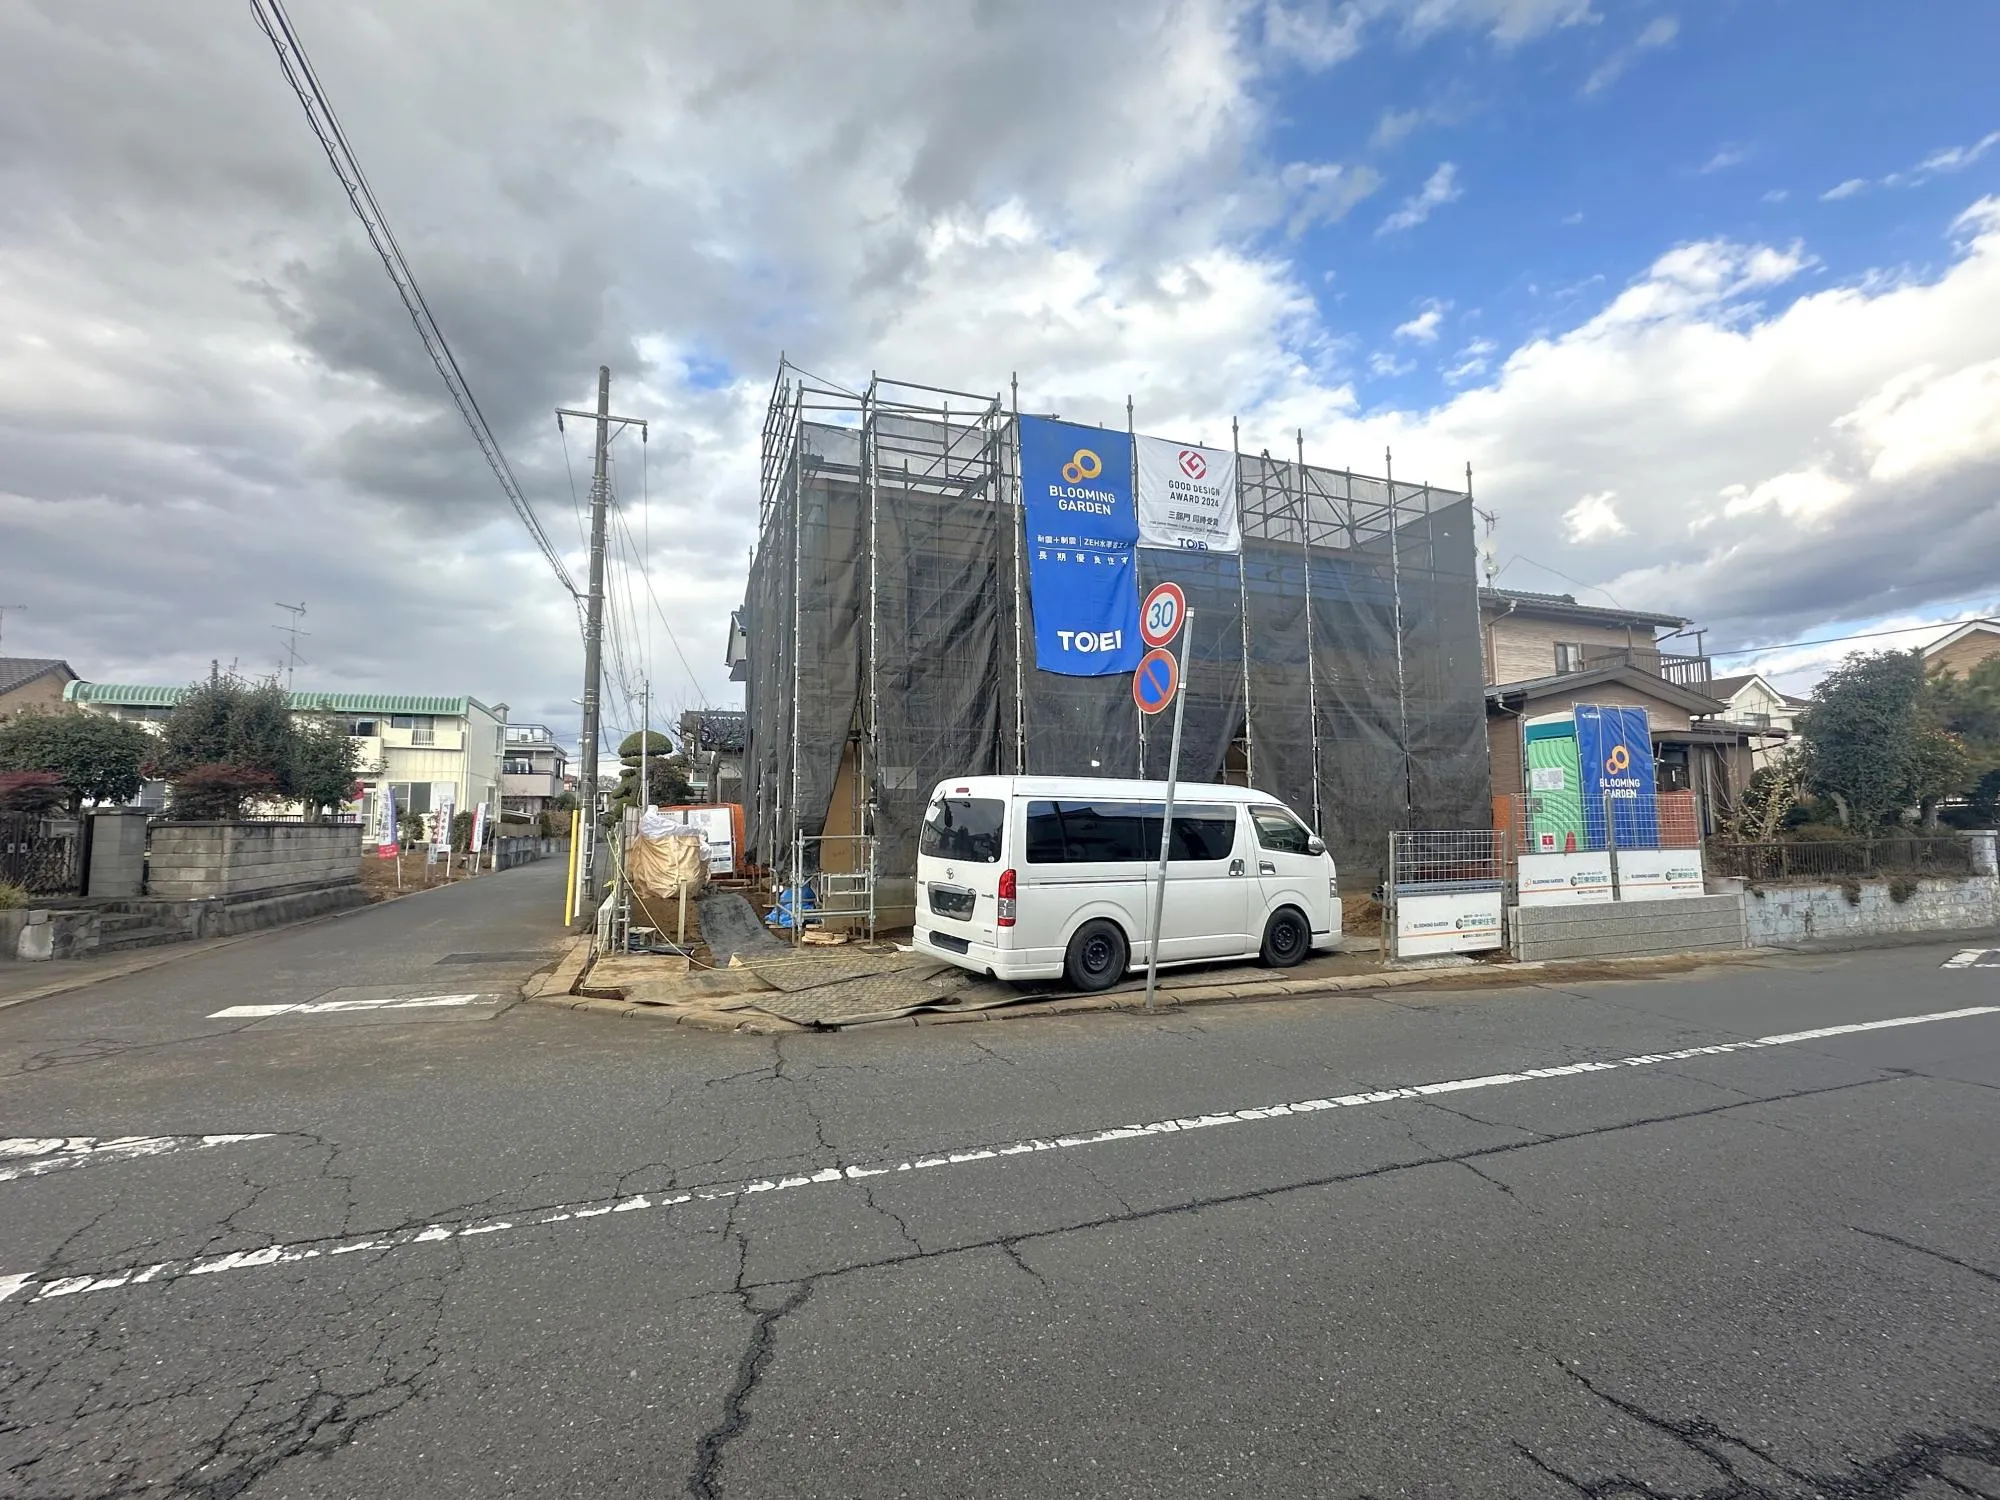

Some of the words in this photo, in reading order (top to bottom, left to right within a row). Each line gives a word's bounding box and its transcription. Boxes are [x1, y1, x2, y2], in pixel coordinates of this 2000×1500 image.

[1049, 485, 1116, 504] BLOOMING
[1168, 479, 1192, 491] GOOD
[1193, 484, 1220, 497] DESIGN
[1058, 499, 1112, 516] GARDEN
[1170, 491, 1200, 504] AWARD
[1201, 496, 1219, 507] 2024
[1149, 600, 1174, 630] 30
[1599, 778, 1641, 788] BLOOMING
